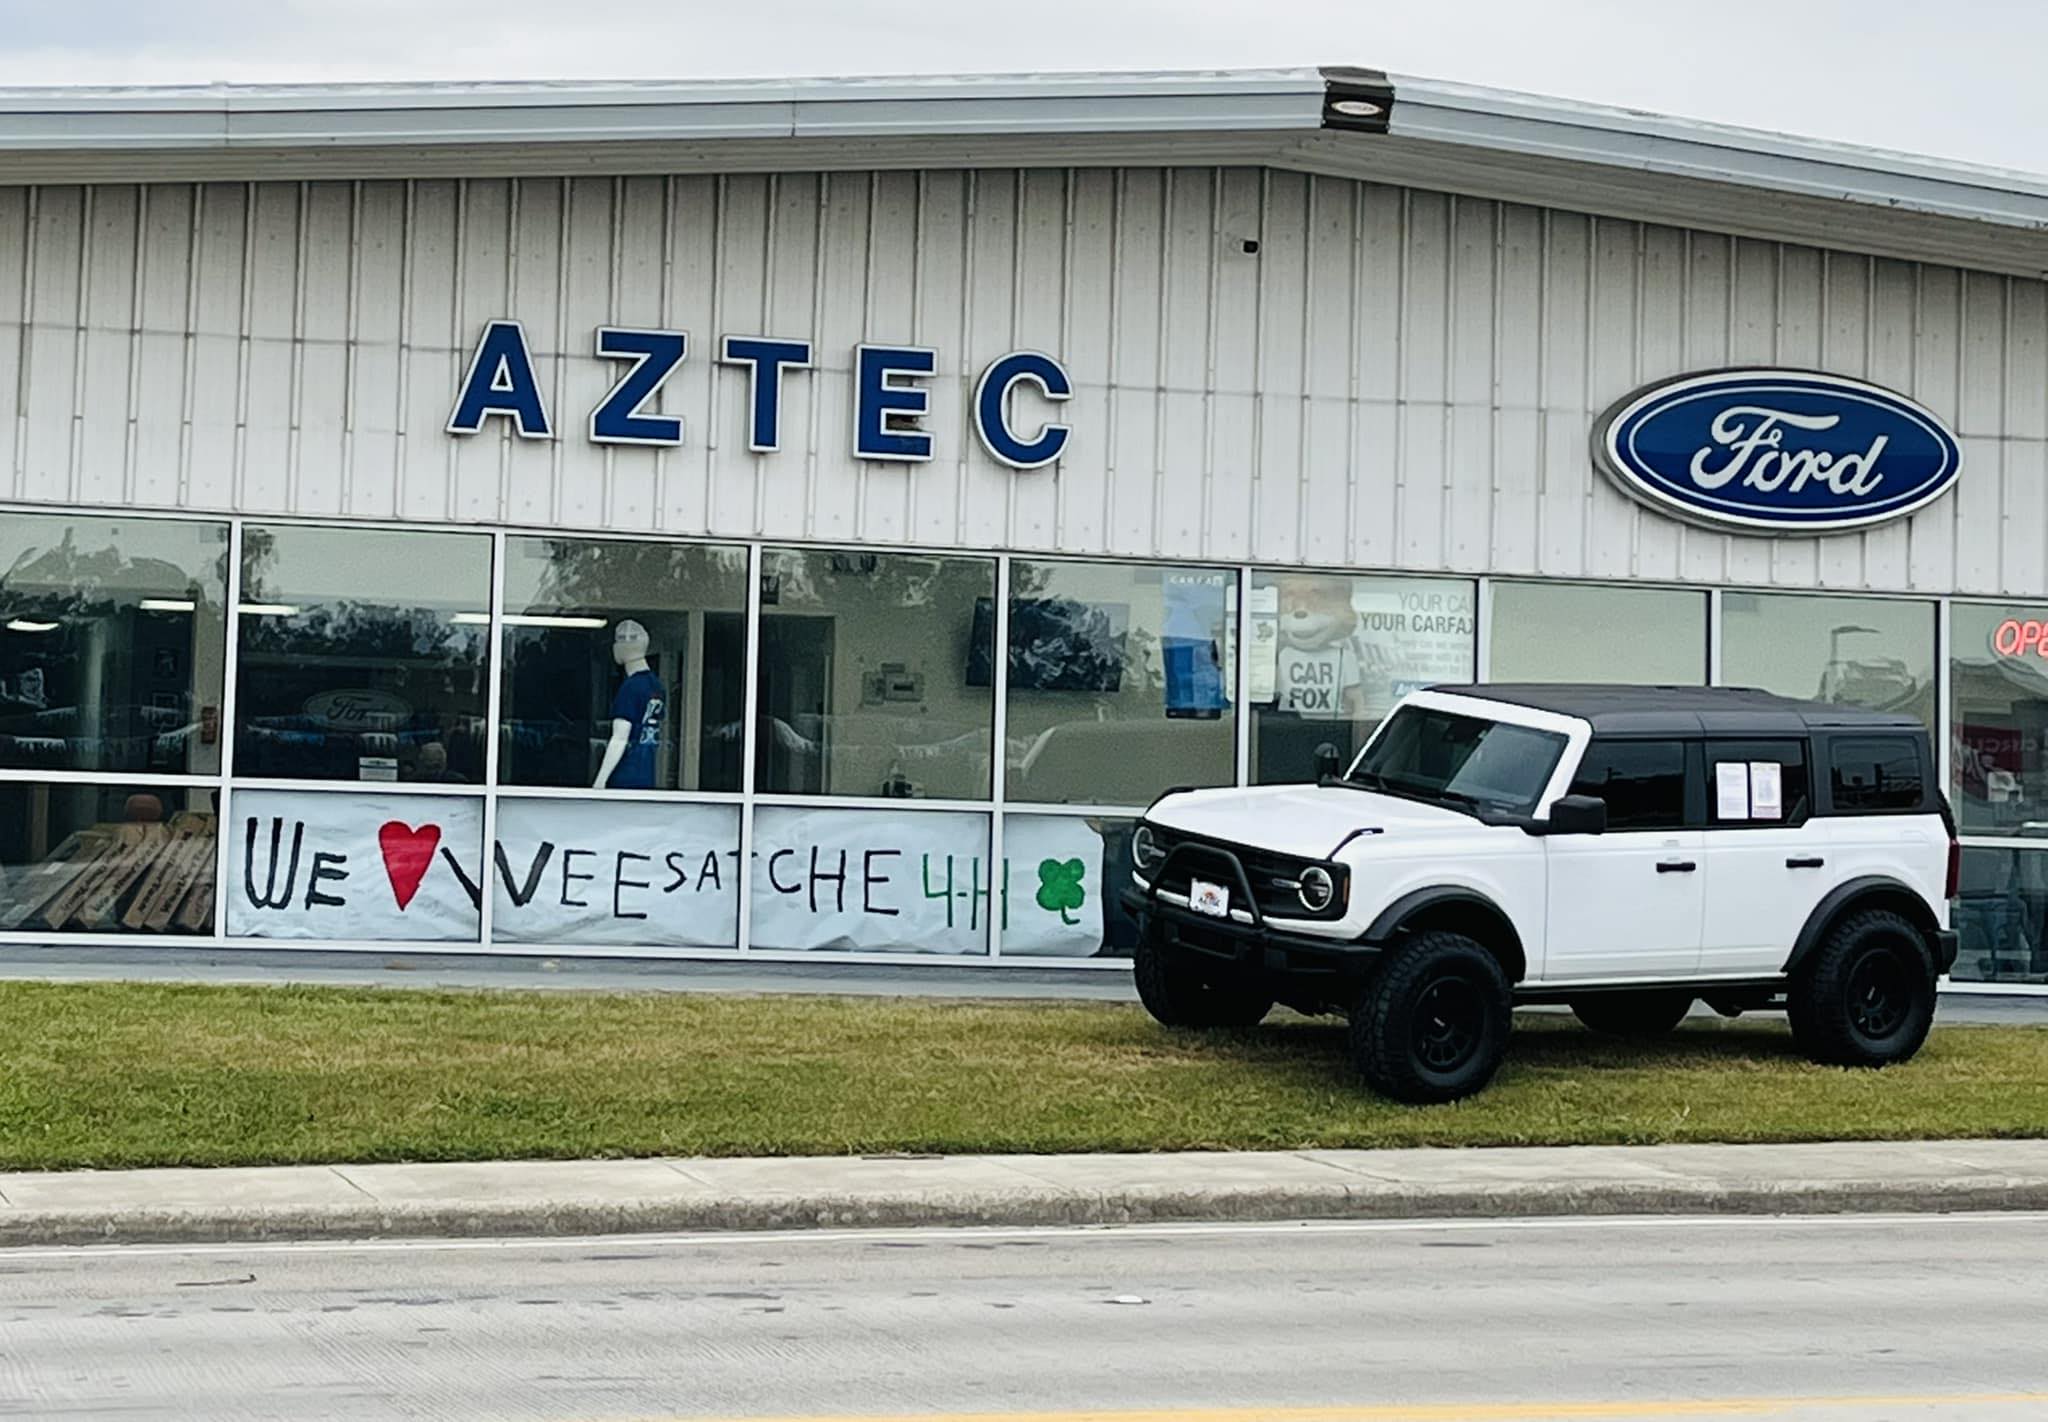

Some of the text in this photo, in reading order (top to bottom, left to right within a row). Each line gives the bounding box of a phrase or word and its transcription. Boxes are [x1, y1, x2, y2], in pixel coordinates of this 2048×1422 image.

[446, 320, 1073, 469] AZTEC
[1689, 405, 1889, 497] Ford
[1399, 591, 1474, 615] YOUR CA
[1360, 612, 1406, 632] YOUR
[1290, 662, 1334, 685] CAR
[1289, 687, 1331, 709] FOX
[245, 816, 350, 911] WE
[921, 852, 1009, 931] 4-H
